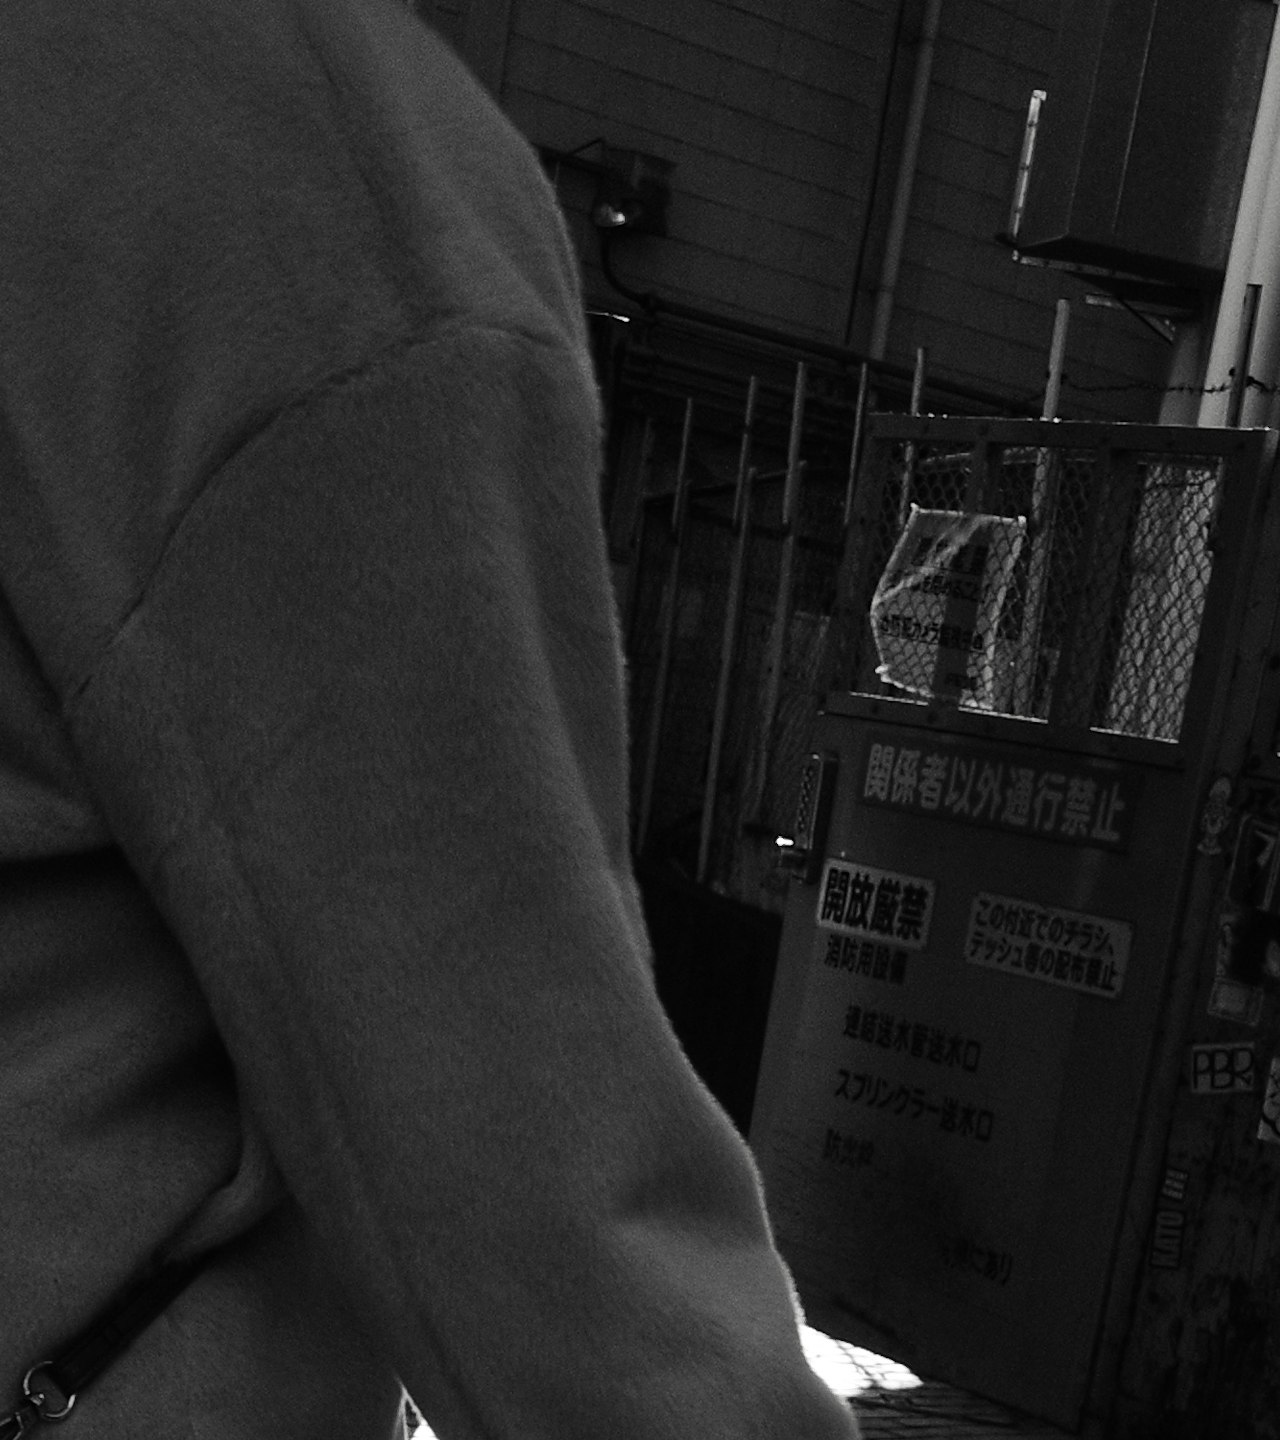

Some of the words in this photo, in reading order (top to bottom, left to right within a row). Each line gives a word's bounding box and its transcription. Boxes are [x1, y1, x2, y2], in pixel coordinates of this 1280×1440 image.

[863, 742, 1126, 843] 関係者以外通行禁止
[821, 868, 928, 940] 開放厳禁
[975, 900, 1114, 956] この付近でのチラシ、
[824, 934, 908, 985] 消防用設備
[843, 1005, 981, 1072] 連結送水管送水口
[1193, 1048, 1254, 1089] PBR
[835, 1069, 994, 1142] スプリンクラー送水口
[1151, 1210, 1186, 1269] KATO
